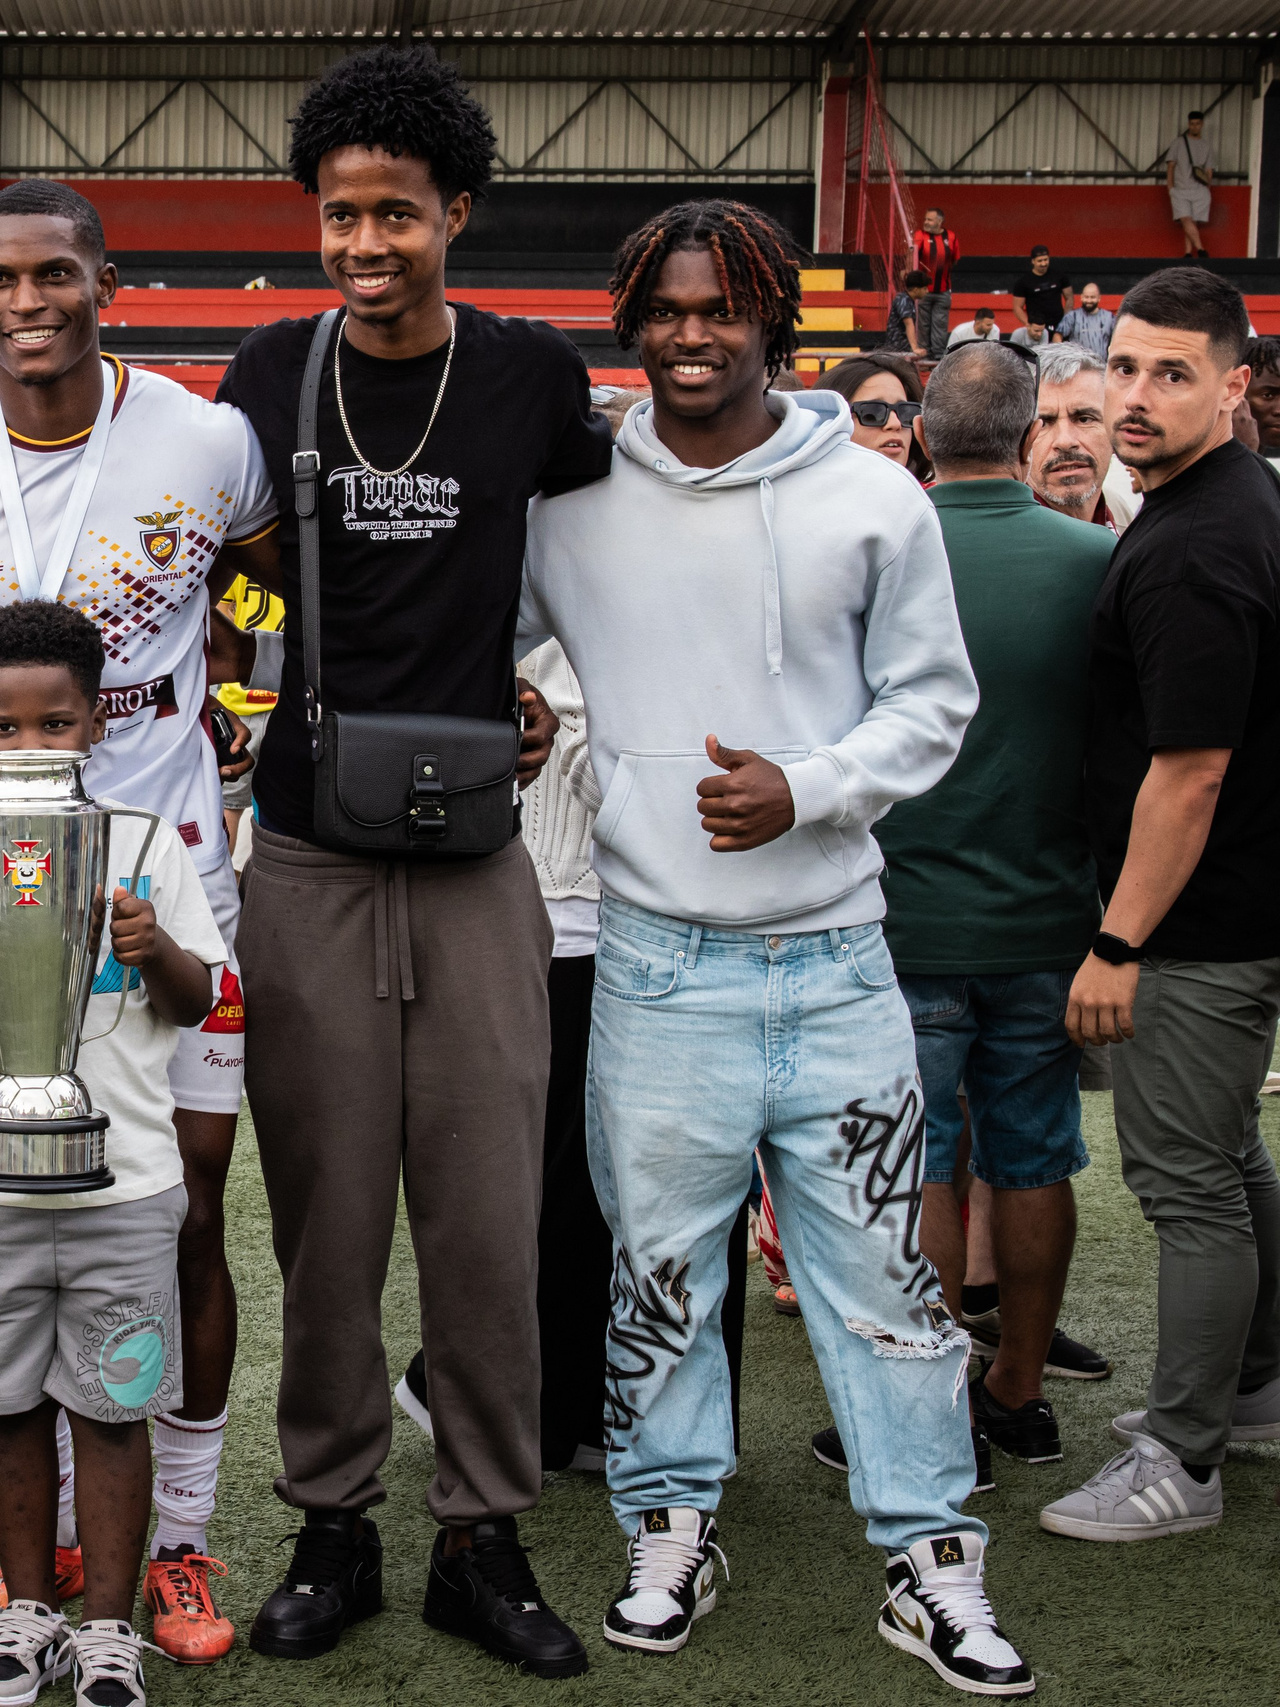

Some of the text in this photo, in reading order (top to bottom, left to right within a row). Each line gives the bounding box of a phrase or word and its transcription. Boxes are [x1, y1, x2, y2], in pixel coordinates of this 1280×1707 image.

[344, 519, 457, 530] UNTIL THE END
[370, 530, 433, 540] OF TIME
[142, 571, 183, 583] ORIENTAL
[113, 1325, 137, 1344] RIDE
